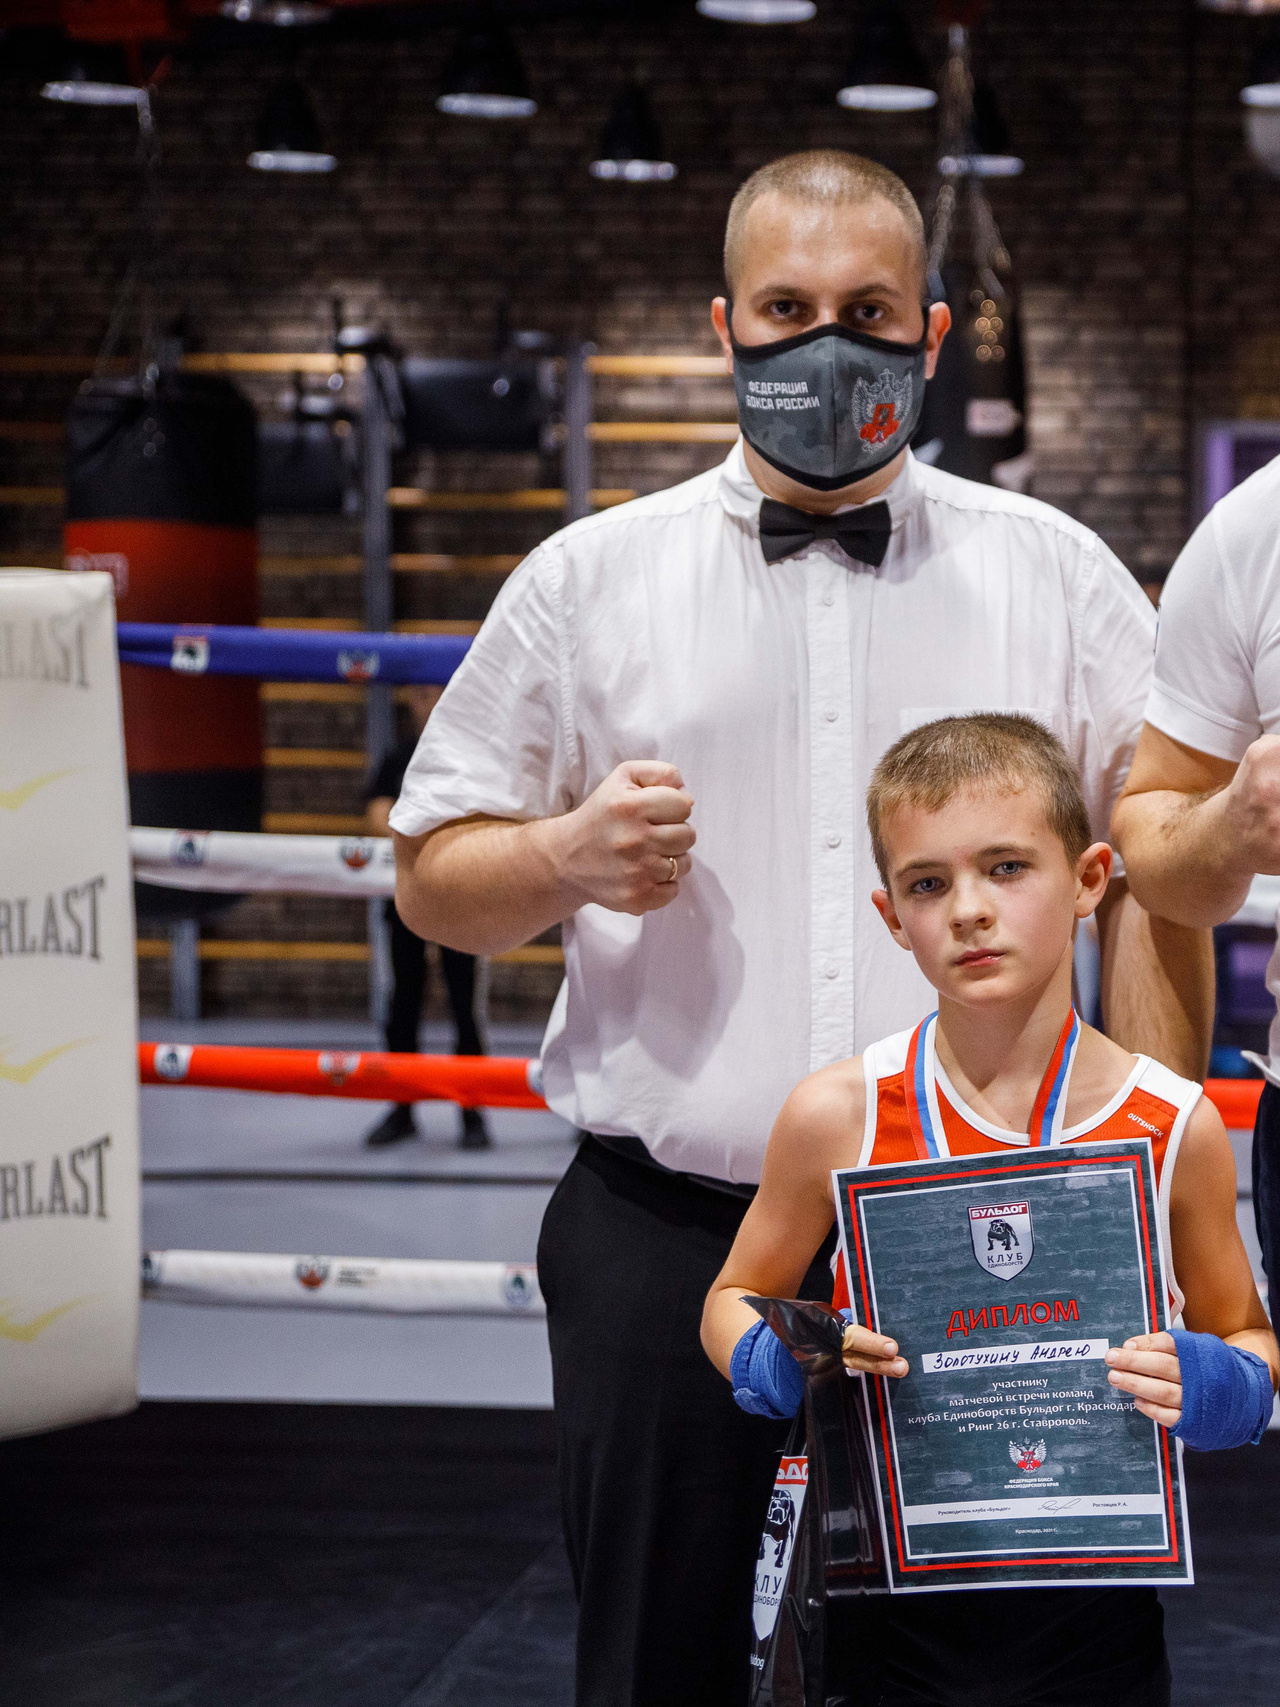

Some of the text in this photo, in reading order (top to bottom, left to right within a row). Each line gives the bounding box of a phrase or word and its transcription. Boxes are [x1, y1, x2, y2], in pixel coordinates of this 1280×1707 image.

[748, 380, 809, 395] ФЕДЕРАЦИЯ
[745, 395, 820, 410] БОКСА РОССИИ
[1127, 1112, 1164, 1138] OUTSHOCK
[971, 1204, 1026, 1218] БУЛЬДОГ
[987, 1252, 1023, 1263] КЛУБ
[946, 1299, 1080, 1339] ДИПЛОМ
[992, 1378, 1048, 1391] участнику
[949, 1389, 1094, 1408] матчевой встречи команд
[908, 1400, 1136, 1426] клуба Единоборств Бульдог г. Краснодар
[959, 1416, 1091, 1433] и Ринг 26 г. Ставрополь.
[938, 1508, 971, 1516] Руководитель
